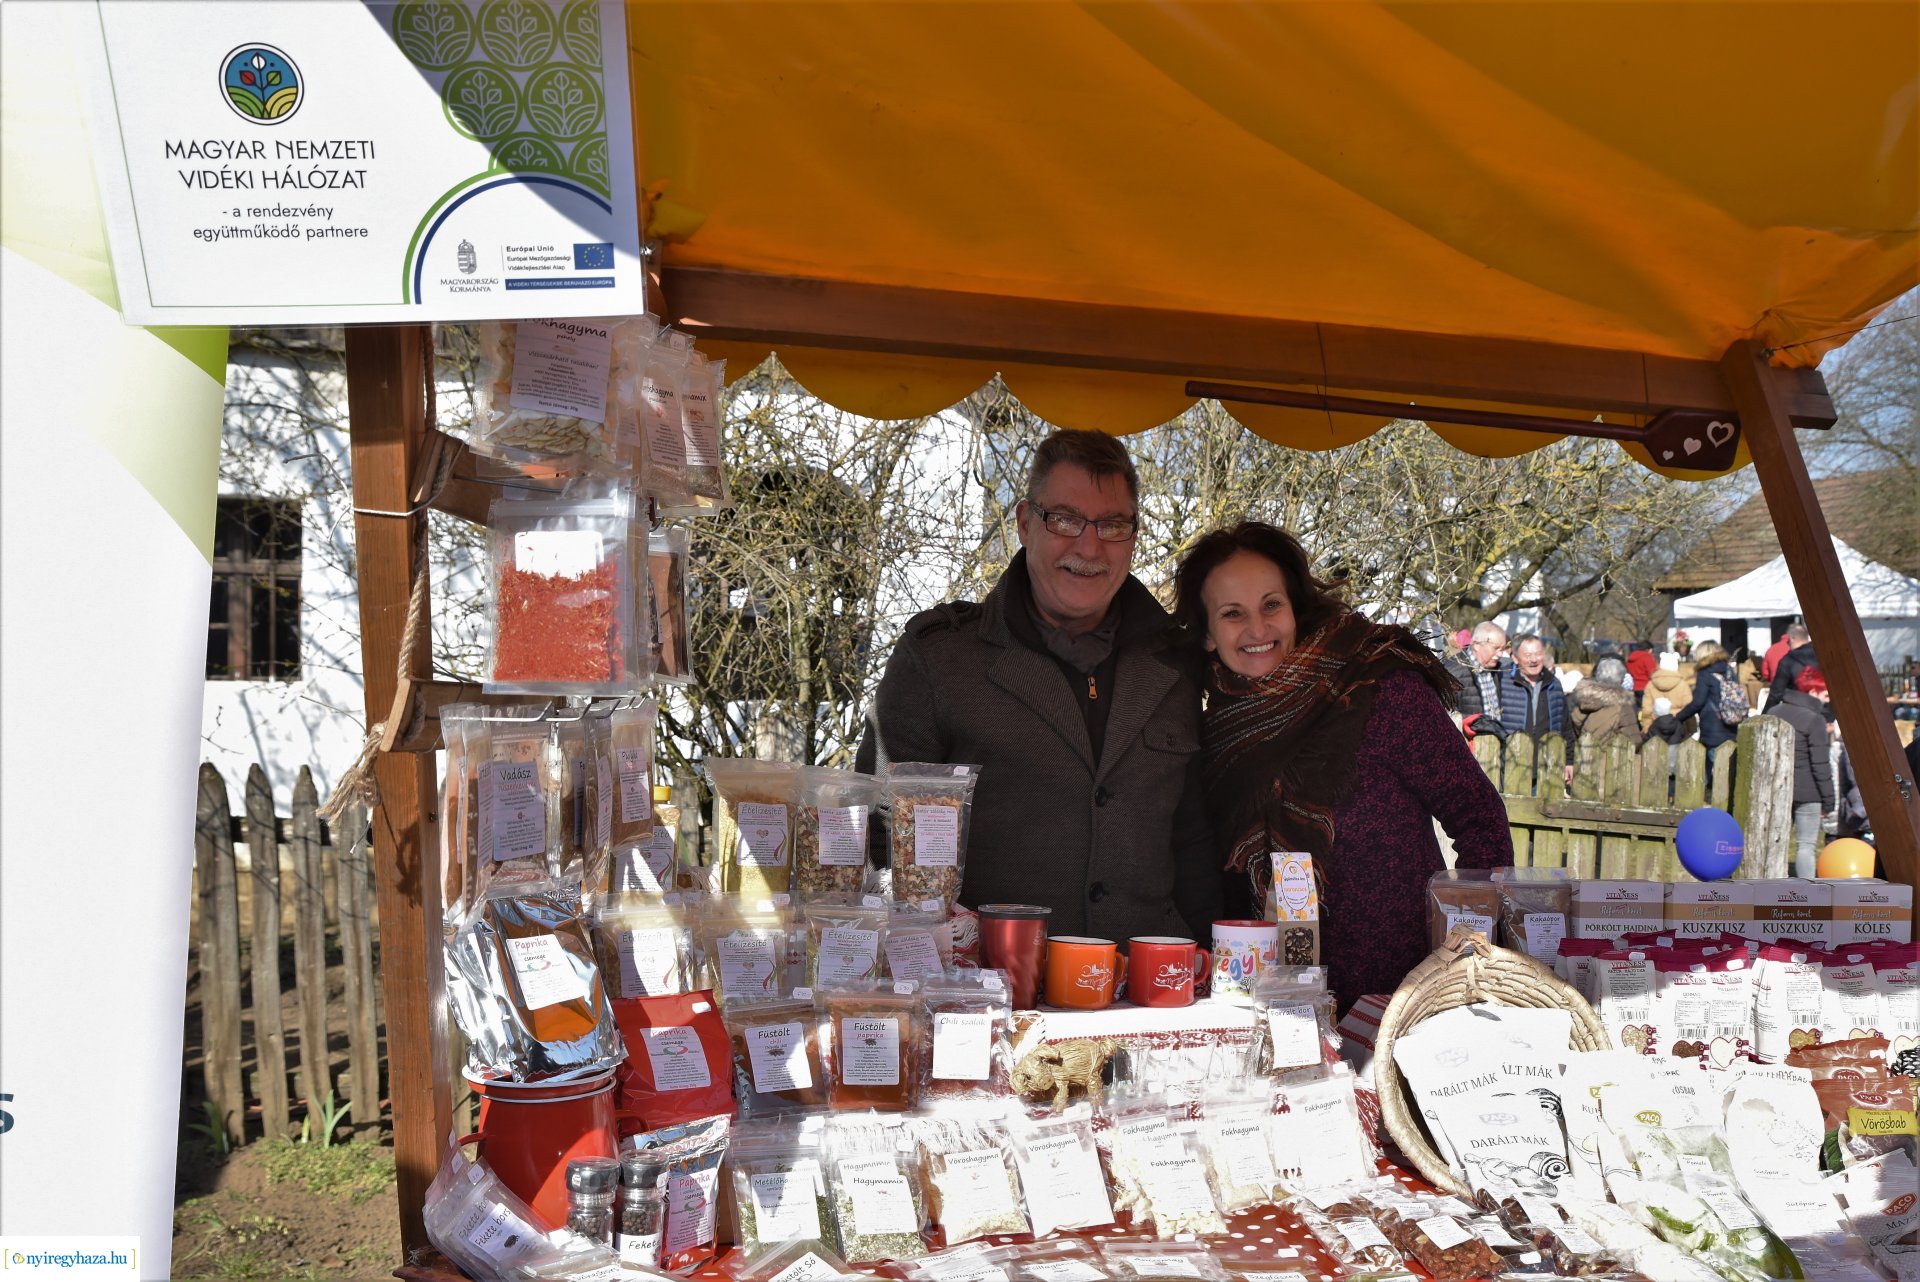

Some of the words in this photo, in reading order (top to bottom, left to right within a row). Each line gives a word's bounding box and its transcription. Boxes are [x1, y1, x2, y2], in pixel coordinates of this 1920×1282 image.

[165, 139, 267, 160] MAGYAR
[275, 139, 376, 160] NEMZETI
[178, 164, 254, 189] VIDÉKI
[261, 164, 368, 189] HÁLÓZAT
[232, 207, 241, 217] a
[247, 202, 334, 220] rendezvény
[193, 223, 301, 242] együttműködő
[306, 224, 369, 242] partnere
[440, 277, 499, 285] MAGYARORSZÁG
[449, 285, 492, 293] KORMÁNYA
[500, 768, 532, 780] Vadász
[1771, 908, 1795, 919] Reform
[1796, 909, 1812, 918] köret
[1453, 916, 1487, 926] Kakaópor
[1530, 916, 1561, 924] Kakaópor
[1585, 923, 1622, 932] PÖRKÖLT
[1623, 924, 1658, 932] HAJDINA
[1682, 922, 1745, 934] KUSZKUSZ
[1762, 922, 1824, 934] KUSZKUSZ
[1854, 922, 1891, 934] KÖLES
[515, 938, 549, 951] Paprika
[1611, 960, 1647, 968] VITANESS
[1270, 1009, 1296, 1017] Forralt
[1297, 1006, 1311, 1014] bor
[854, 1021, 886, 1031] Füstölt
[940, 1017, 958, 1025] Chili
[651, 1028, 688, 1039] Paprika
[758, 1027, 791, 1039] Füstölt
[856, 1032, 884, 1041] paprika
[1525, 1065, 1553, 1079] MÁK
[1470, 1072, 1498, 1089] MÁK
[1859, 1094, 1883, 1102] PACO
[1304, 1098, 1343, 1114] Fokhagyma
[1639, 1114, 1660, 1123] PACO
[1860, 1115, 1907, 1130] Vörösbab
[1123, 1121, 1166, 1135] Fokhagyma
[1221, 1125, 1260, 1137] Fokhagyma
[1470, 1135, 1520, 1149] DARÁLT
[1521, 1134, 1550, 1146] MÁK
[1150, 1157, 1197, 1168] Fokhagyma
[679, 1174, 711, 1189] Paprika
[853, 1177, 904, 1188] Hagymamix
[1886, 1195, 1913, 1214] PACO
[475, 1225, 497, 1247] Fekete
[492, 1208, 511, 1226] bors
[804, 1257, 817, 1269] Só
